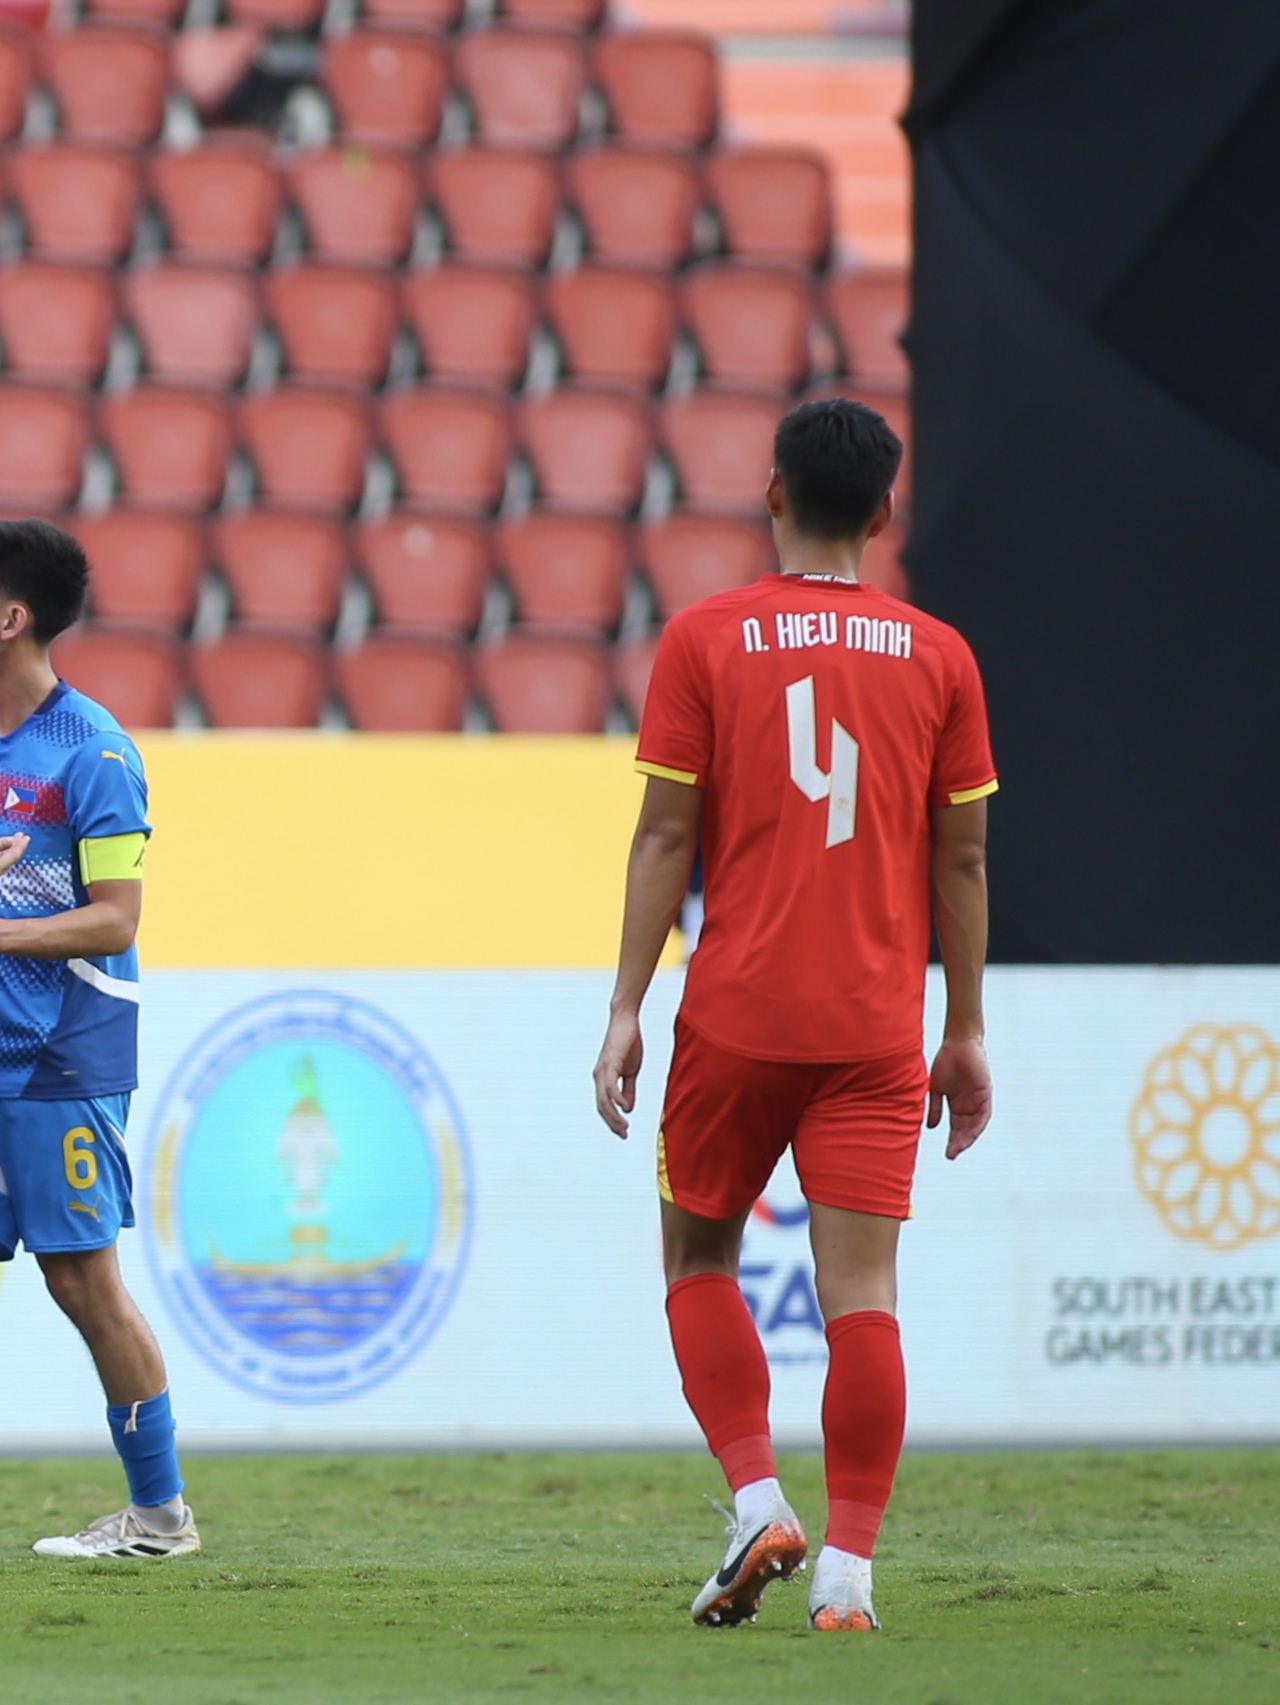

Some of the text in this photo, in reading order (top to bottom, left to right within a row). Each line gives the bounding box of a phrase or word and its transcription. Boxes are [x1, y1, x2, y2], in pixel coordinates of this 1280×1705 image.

[742, 611, 912, 659] N. HIEU MINH
[785, 674, 860, 850] 4
[62, 1126, 98, 1190] 6
[1051, 1276, 1276, 1316] SOUTH EAST
[1045, 1325, 1174, 1366] GAMES
